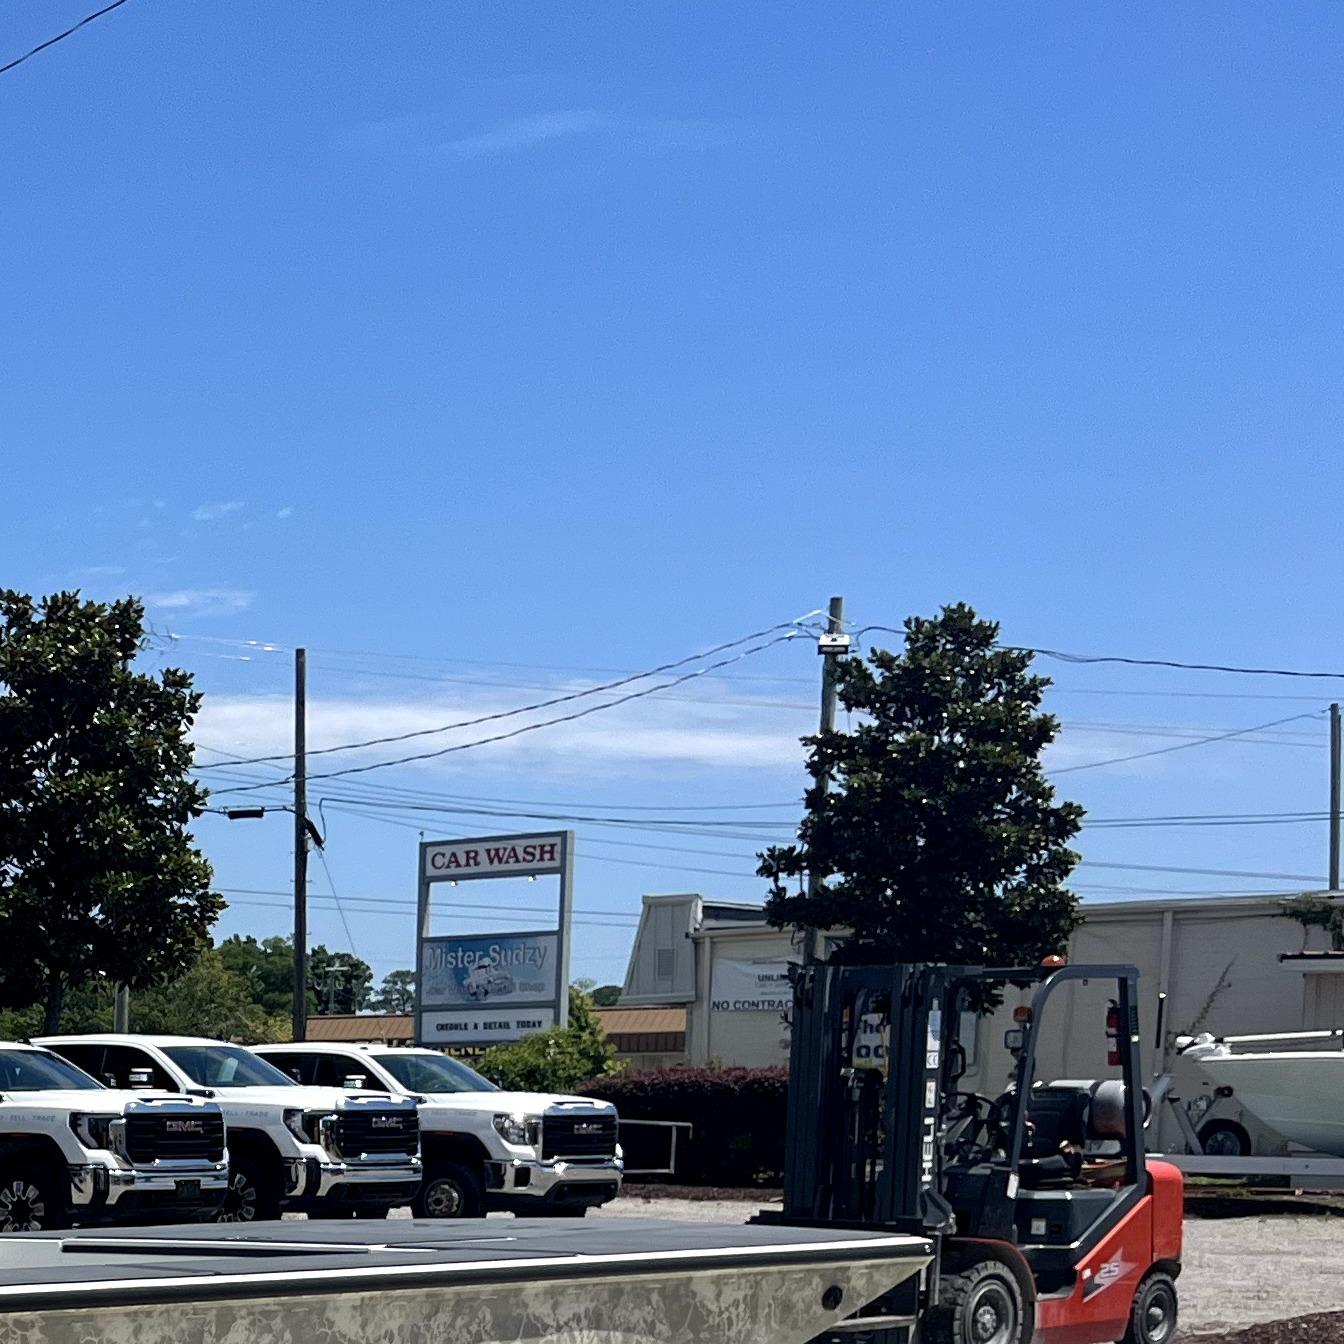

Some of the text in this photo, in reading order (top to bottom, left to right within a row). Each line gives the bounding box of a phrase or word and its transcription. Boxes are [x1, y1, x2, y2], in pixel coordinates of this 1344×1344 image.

[431, 843, 558, 869] CAR WASH
[425, 942, 549, 971] Mister Sudzy
[712, 1001, 730, 1011] NO
[516, 1020, 543, 1029] TODAY
[166, 1120, 205, 1133] GMC
[921, 1116, 935, 1183] HELI
[1099, 1262, 1120, 1278] 25
